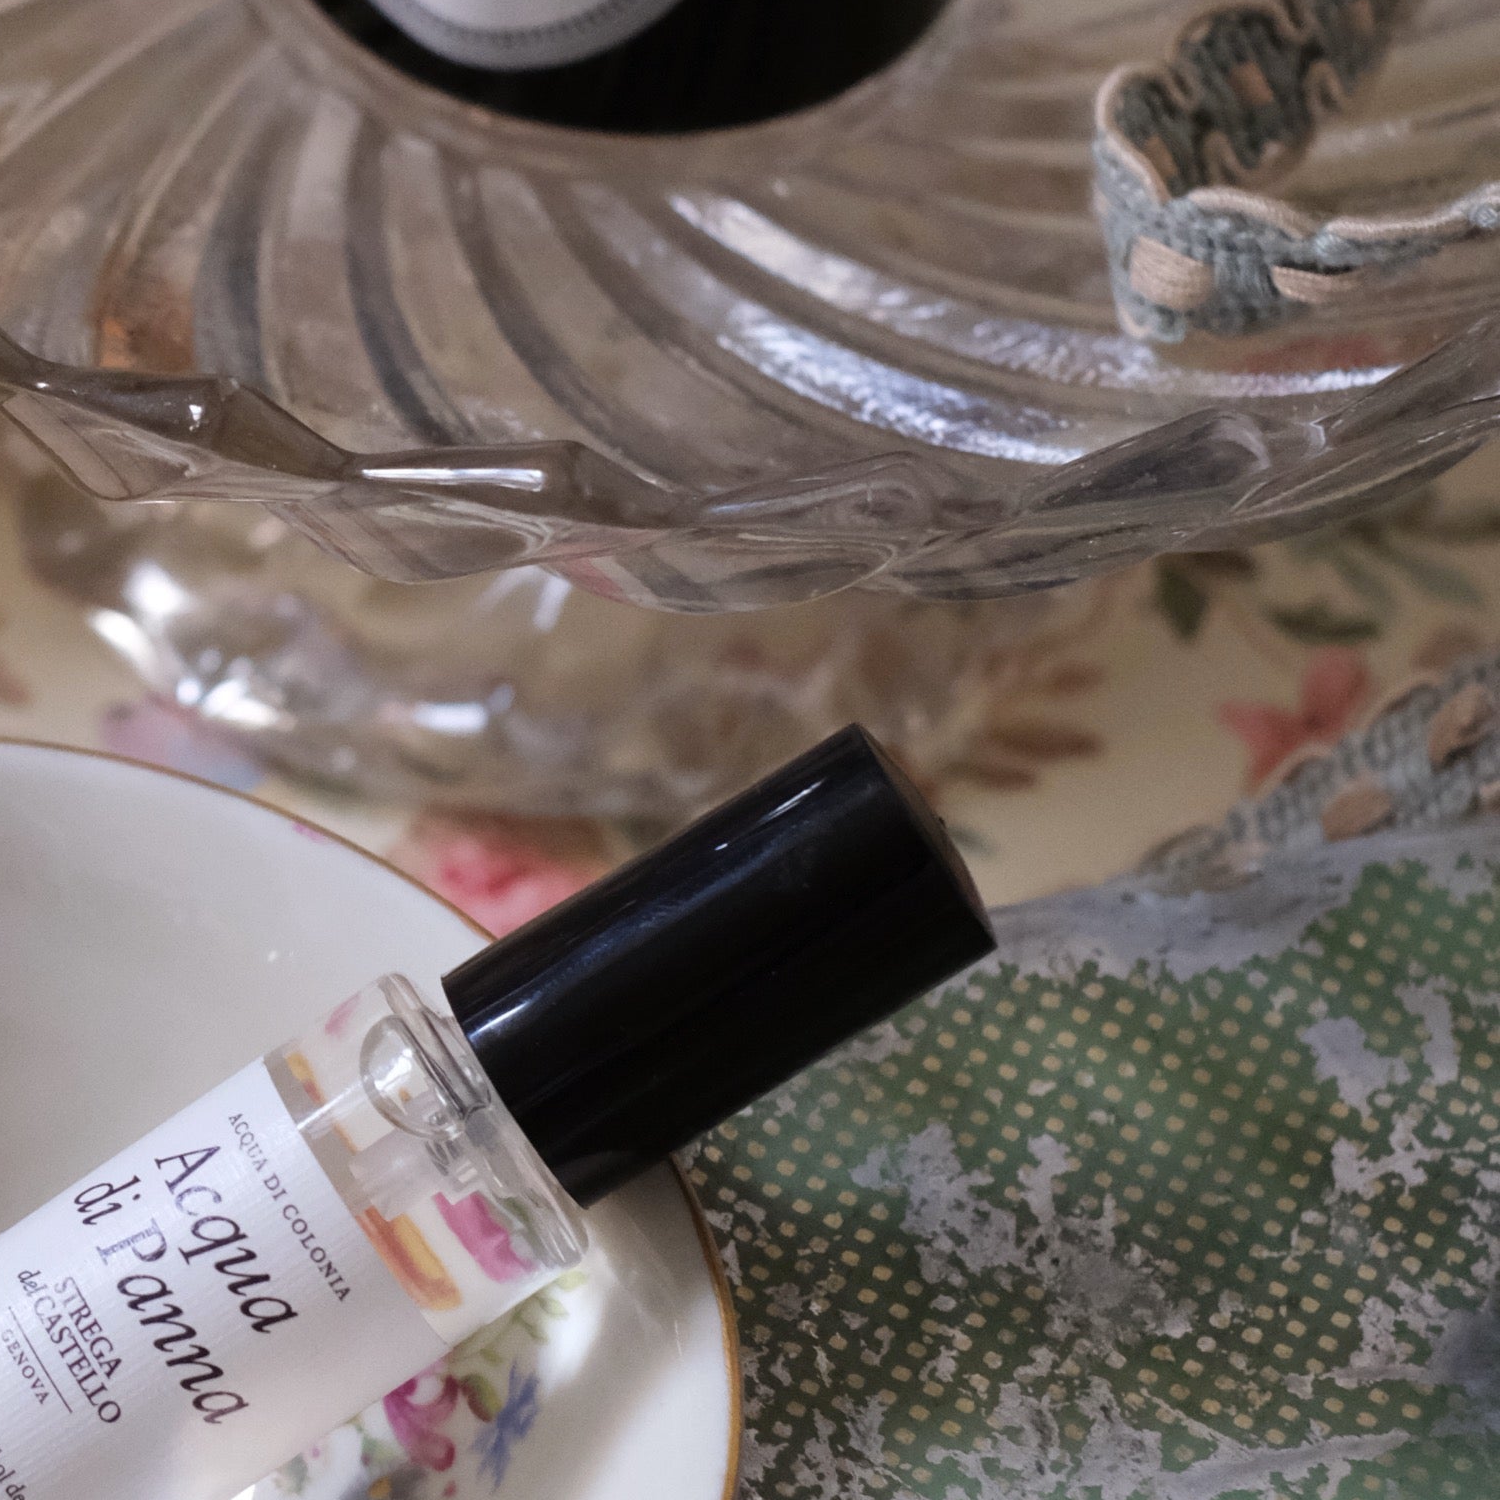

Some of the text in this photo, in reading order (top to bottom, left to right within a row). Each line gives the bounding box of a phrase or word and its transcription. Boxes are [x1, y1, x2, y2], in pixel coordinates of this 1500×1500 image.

[153, 1145, 299, 1335] Acqua
[227, 1112, 352, 1303] ACQUA DI COLONIA
[1, 1328, 50, 1406] GENOVA
[16, 1269, 122, 1424] del CASTELLO
[54, 1276, 123, 1380] STREGA
[73, 1174, 250, 1425] di Panna
